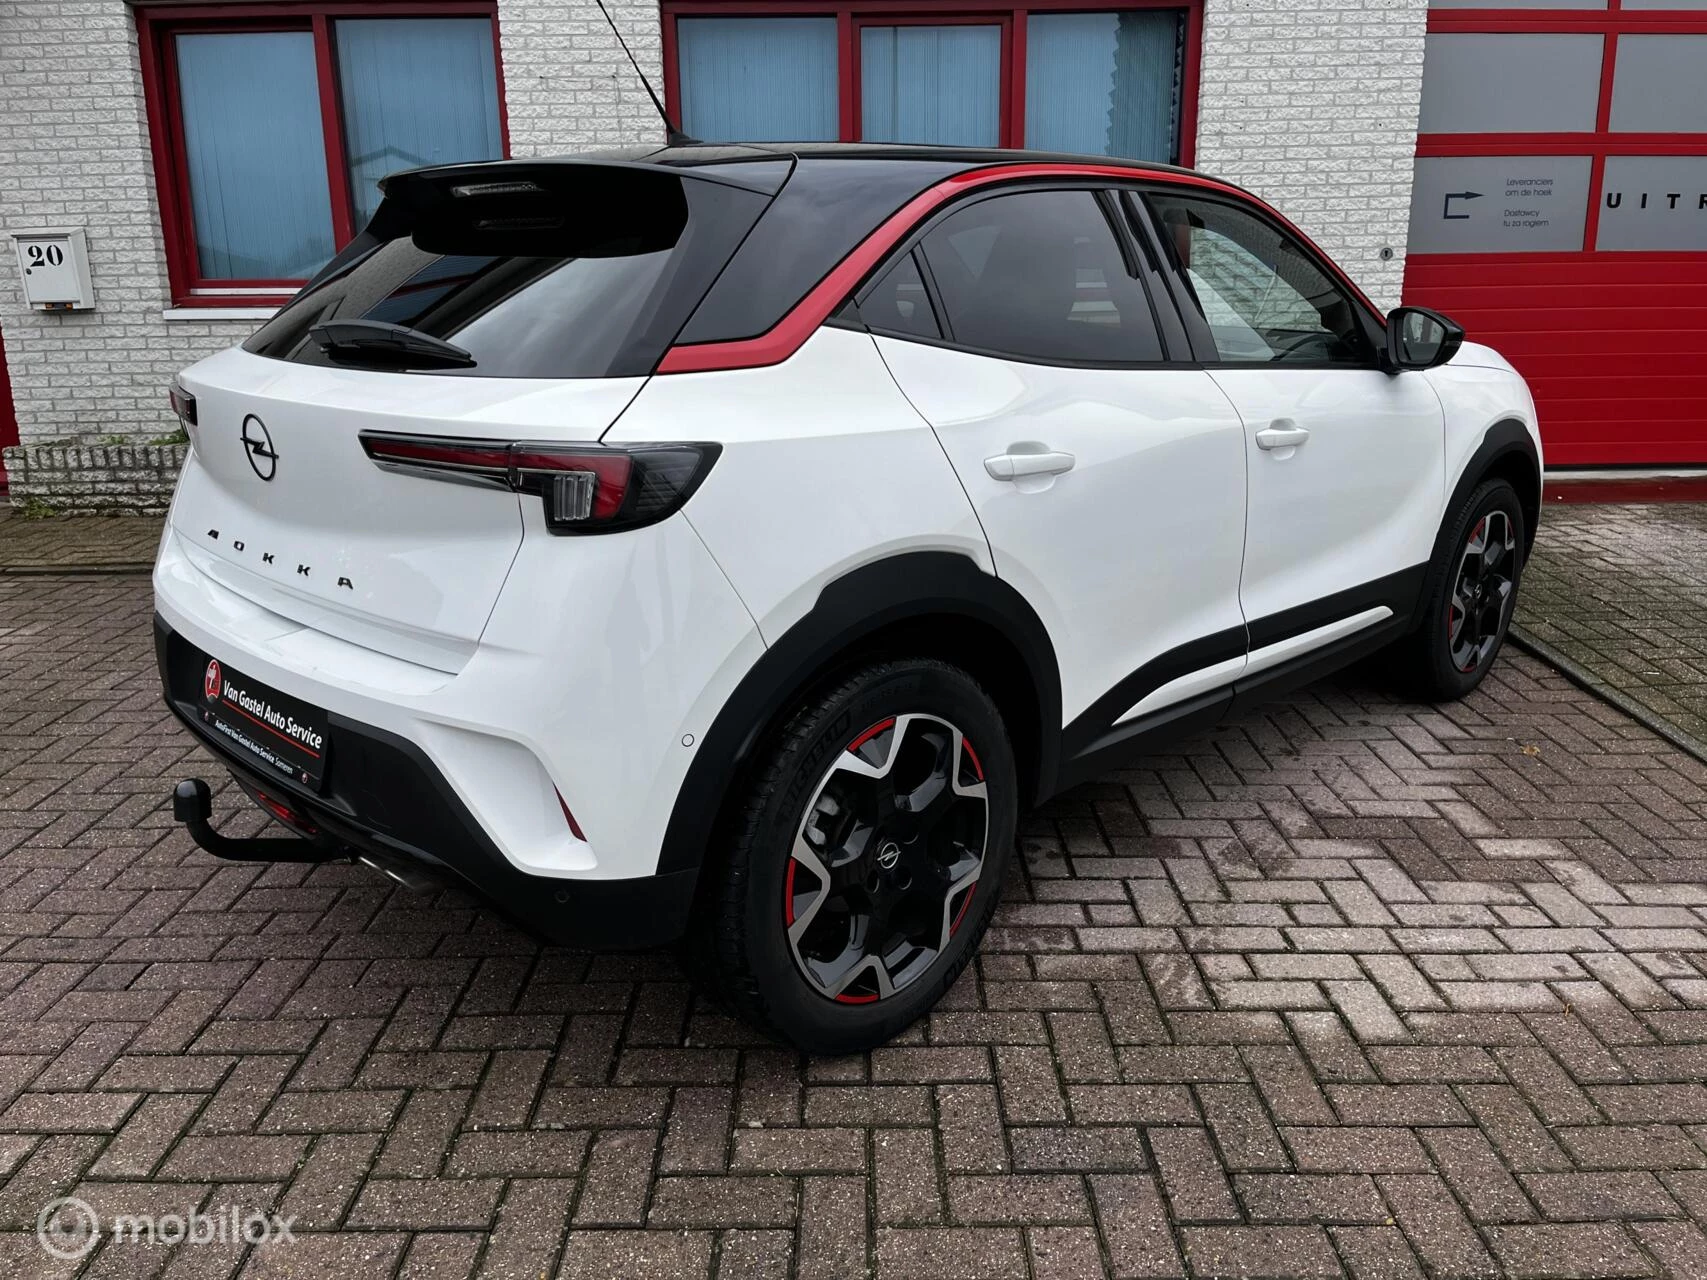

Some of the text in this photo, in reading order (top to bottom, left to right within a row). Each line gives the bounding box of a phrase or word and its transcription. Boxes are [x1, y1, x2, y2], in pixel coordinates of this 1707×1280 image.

[1506, 178, 1553, 186] Leveranciers
[1503, 209, 1539, 217] Dostawcy
[1503, 219, 1511, 227] tu
[27, 244, 63, 267] 20
[223, 679, 322, 749] Van Gastel Auto Service
[215, 720, 293, 774] AutoFirst Van Gastel Auto Service Someren
